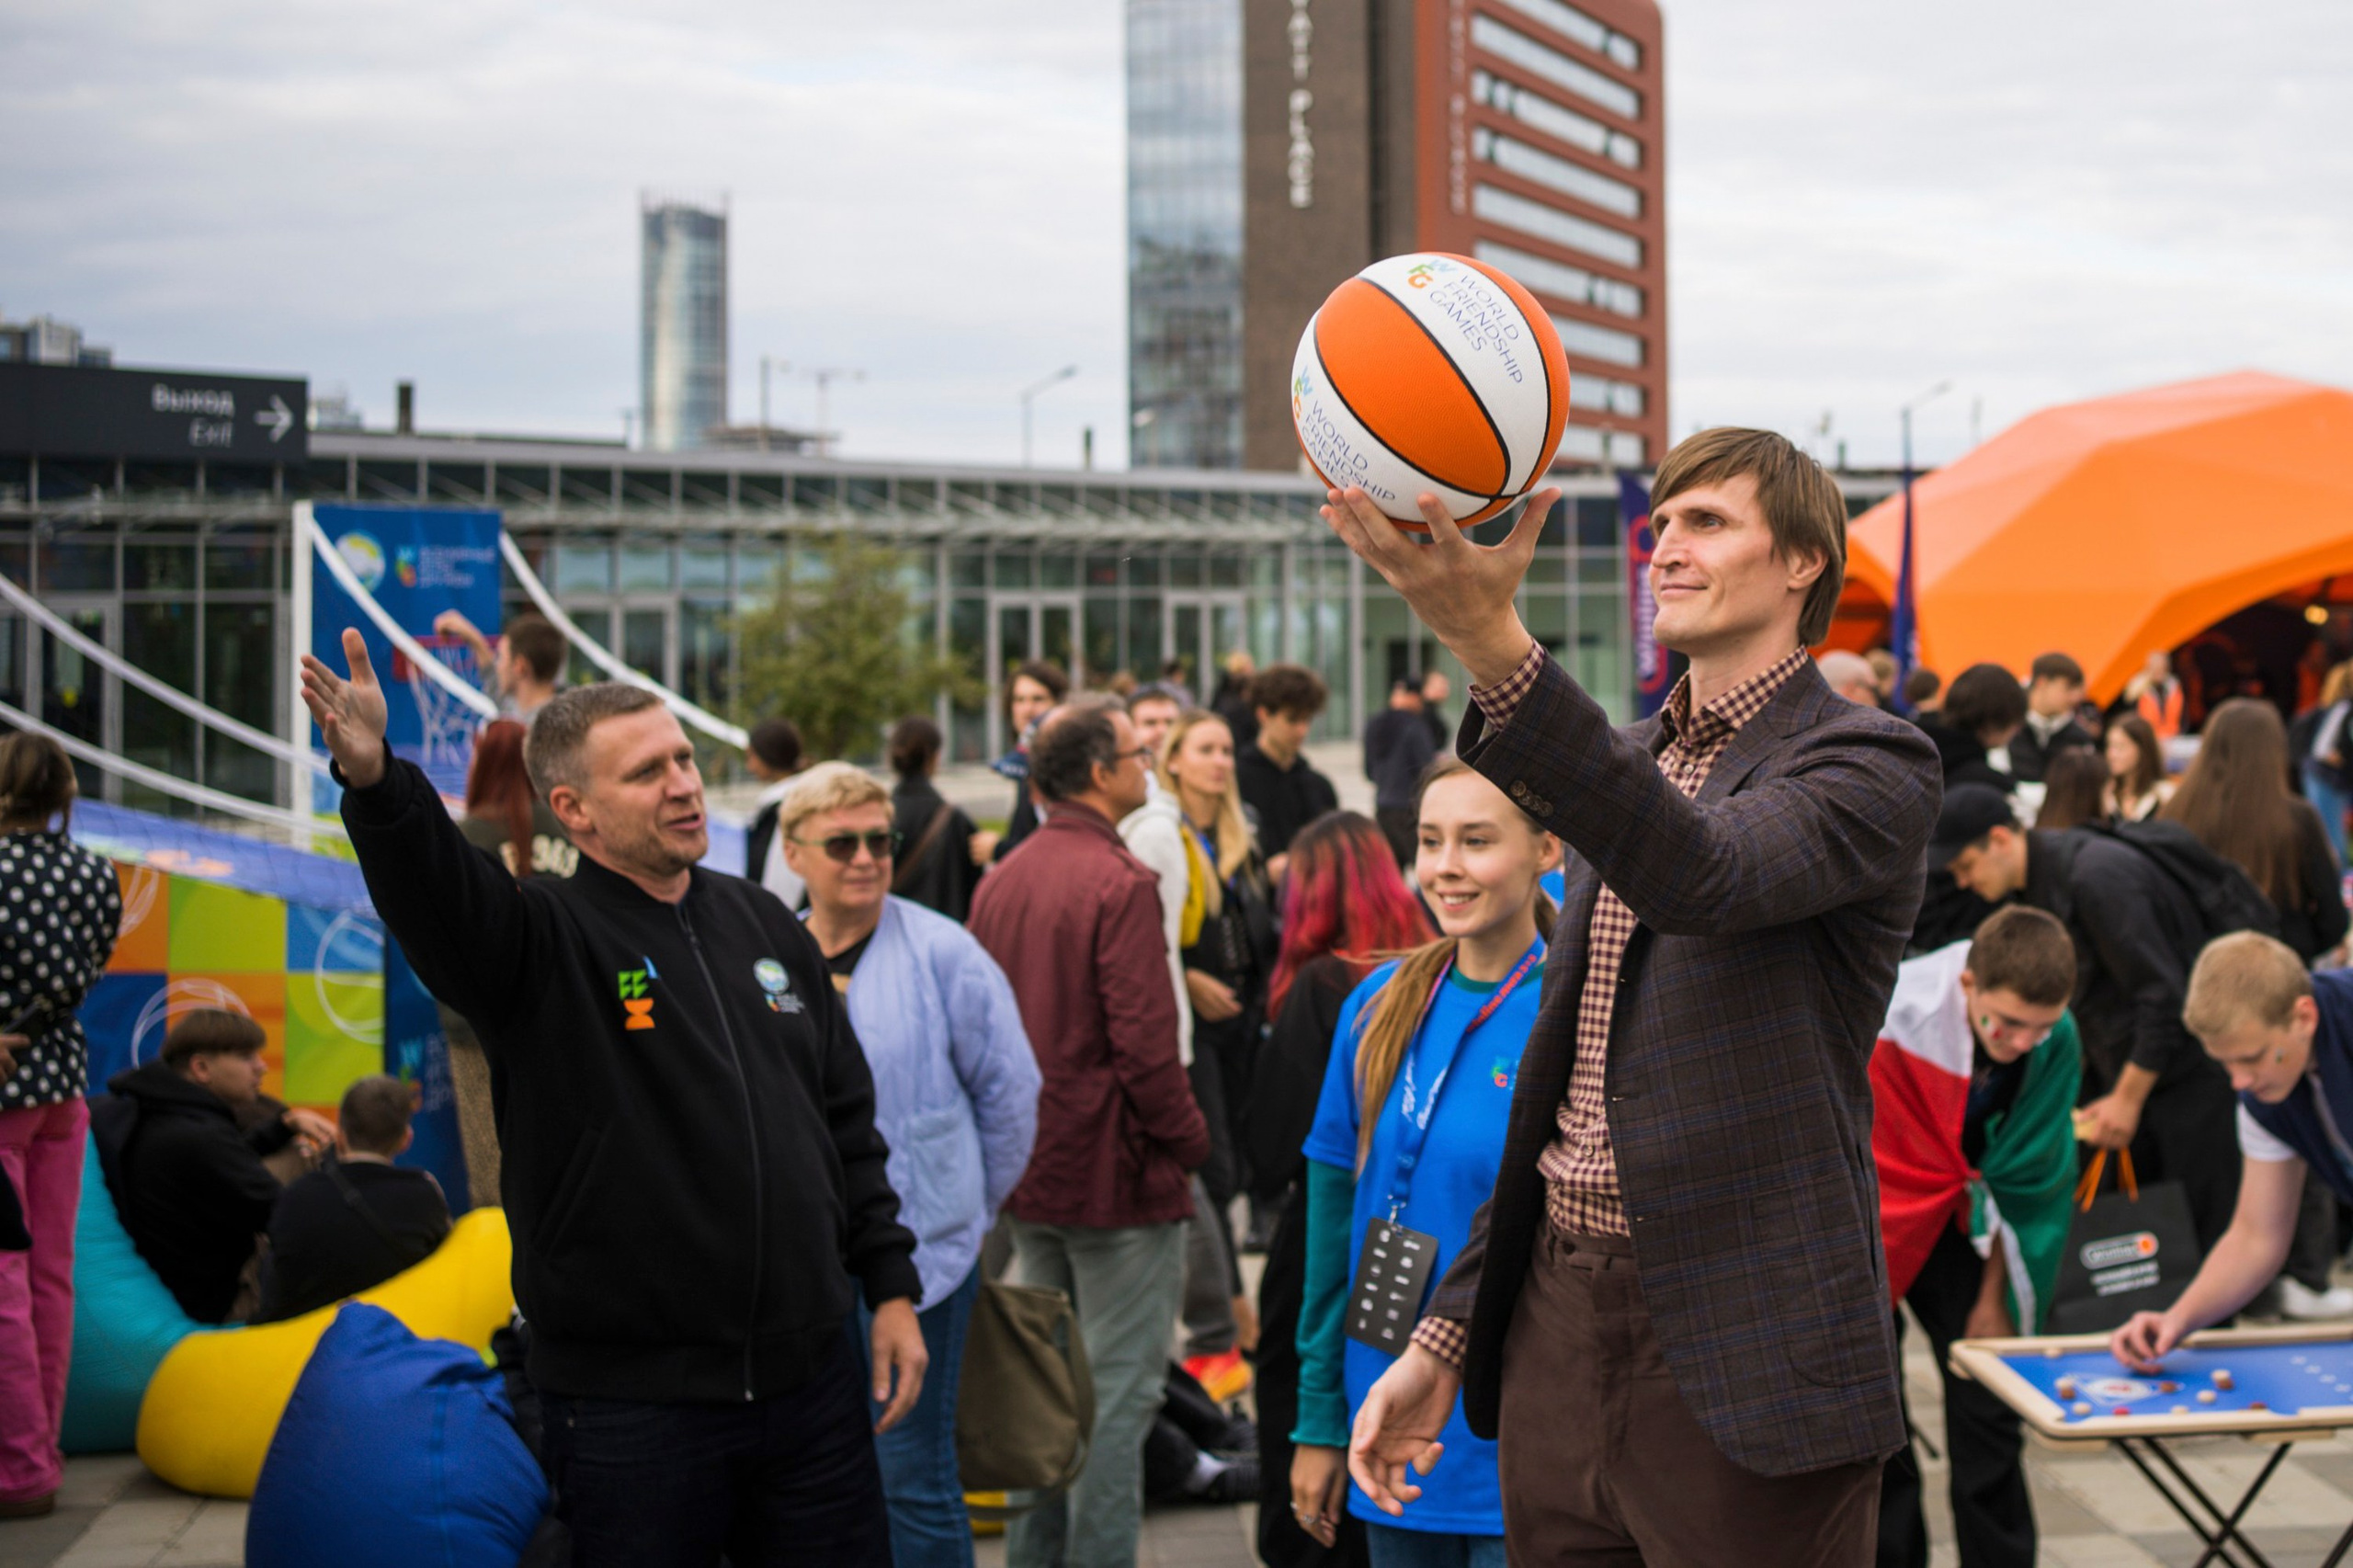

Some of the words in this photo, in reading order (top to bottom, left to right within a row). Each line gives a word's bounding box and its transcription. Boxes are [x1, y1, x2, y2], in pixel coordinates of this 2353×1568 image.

[1430, 290, 1487, 351] GAMES
[1444, 281, 1523, 383] FRIENDSHIP
[1461, 275, 1519, 340] WORLD
[152, 383, 234, 416] Выход
[189, 418, 233, 447] Exit
[1302, 426, 1348, 488] GAMES
[1305, 414, 1395, 500] FRIENDSHIP
[1313, 400, 1368, 471] WORLD
